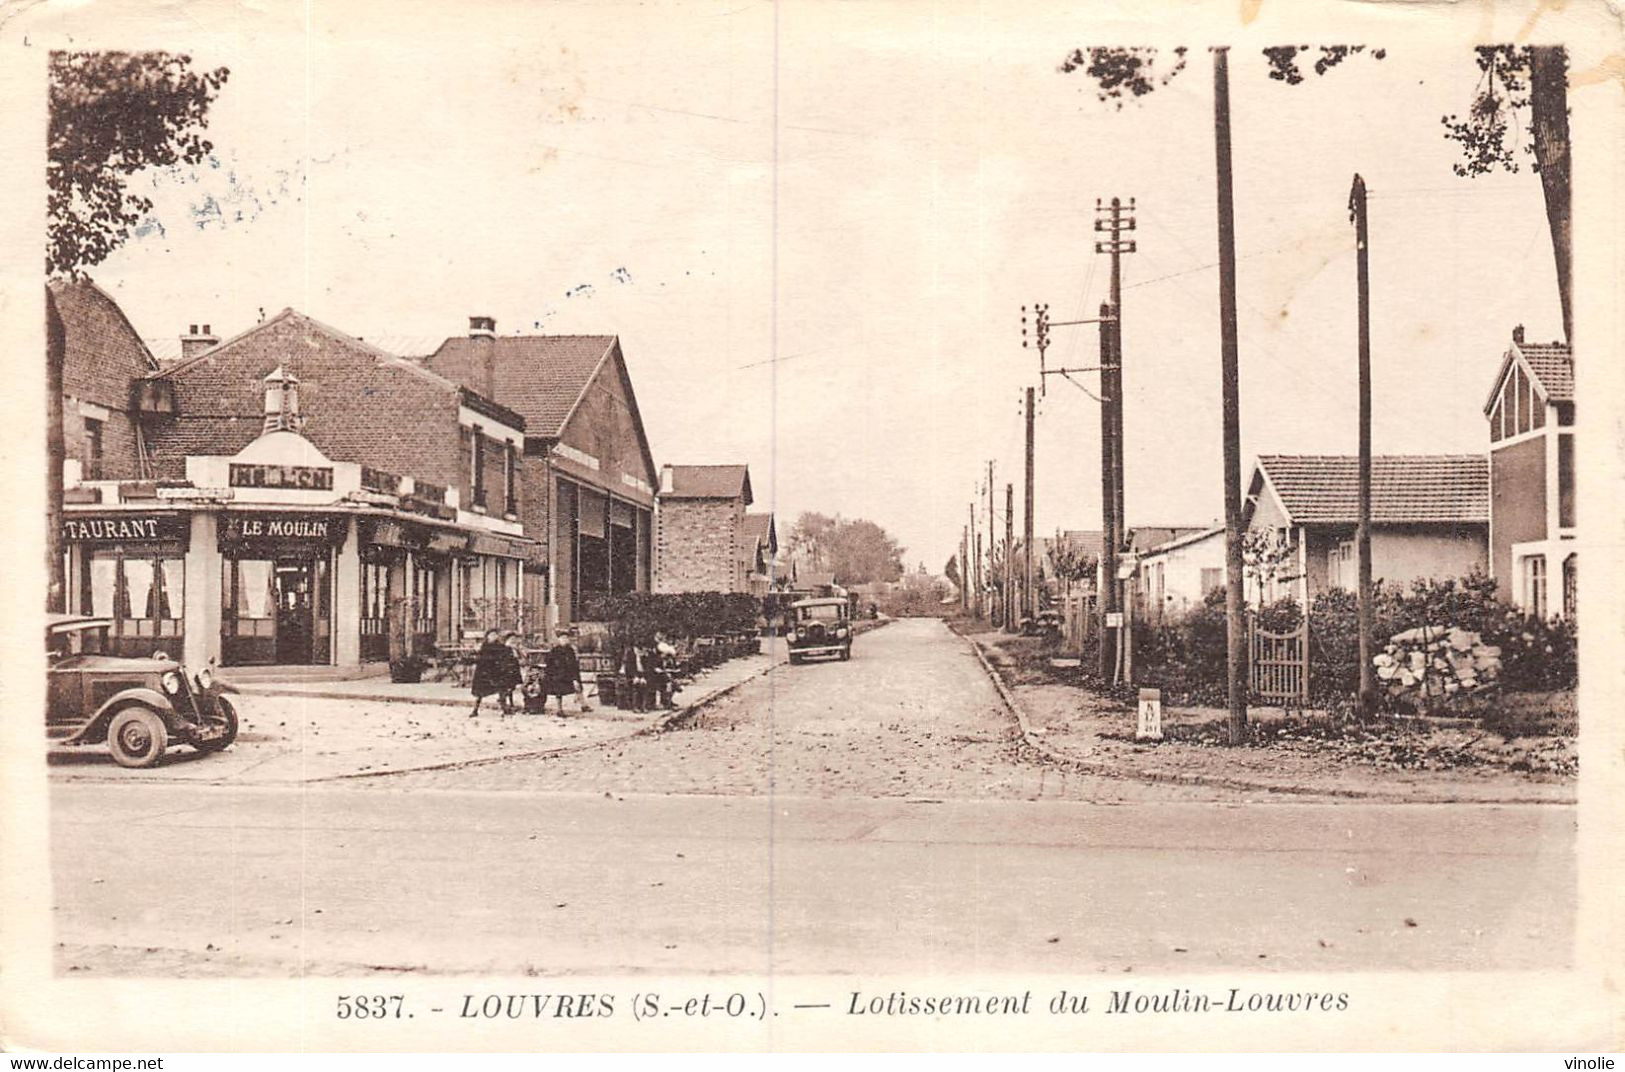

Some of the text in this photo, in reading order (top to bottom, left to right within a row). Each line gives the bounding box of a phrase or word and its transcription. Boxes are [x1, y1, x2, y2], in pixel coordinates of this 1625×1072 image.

[62, 519, 158, 539] TAURANT
[243, 521, 328, 537] LE MOULIN
